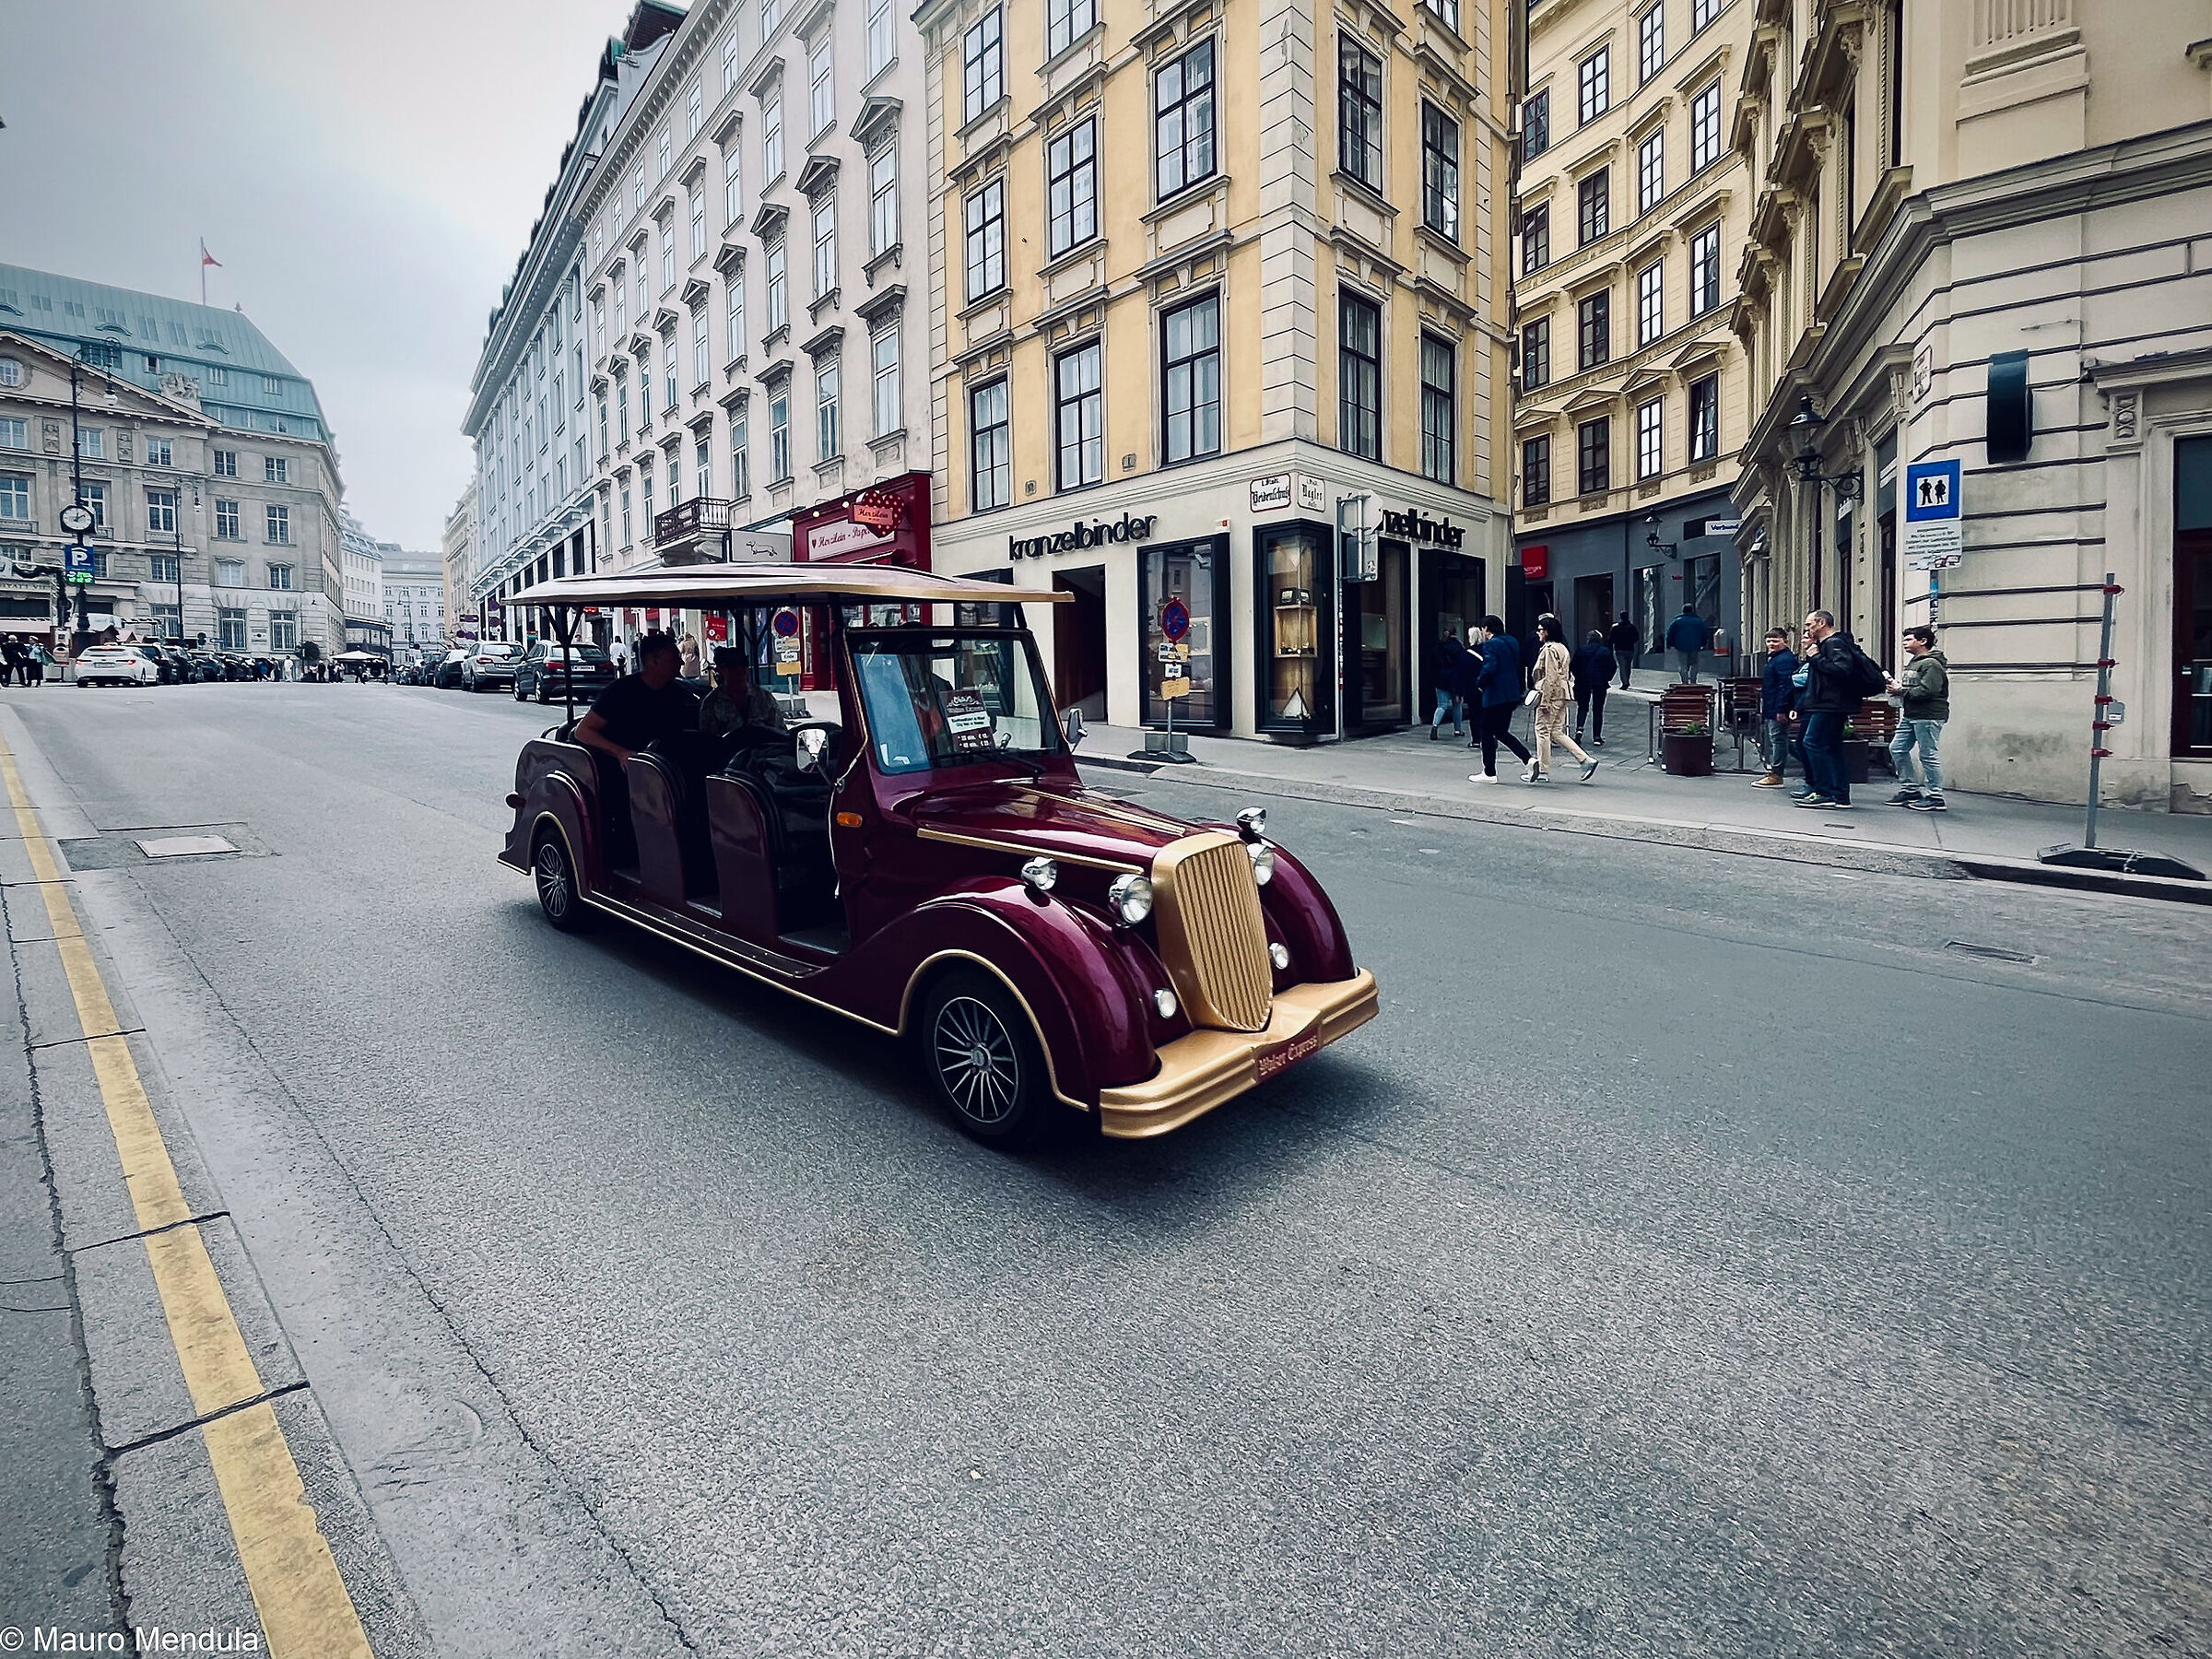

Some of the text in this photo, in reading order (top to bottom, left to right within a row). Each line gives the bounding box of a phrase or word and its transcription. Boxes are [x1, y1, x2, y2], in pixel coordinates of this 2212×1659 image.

[1009, 512, 1158, 561] kranzelbinder
[1377, 508, 1466, 548] nzelbinder
[72, 550, 88, 566] P
